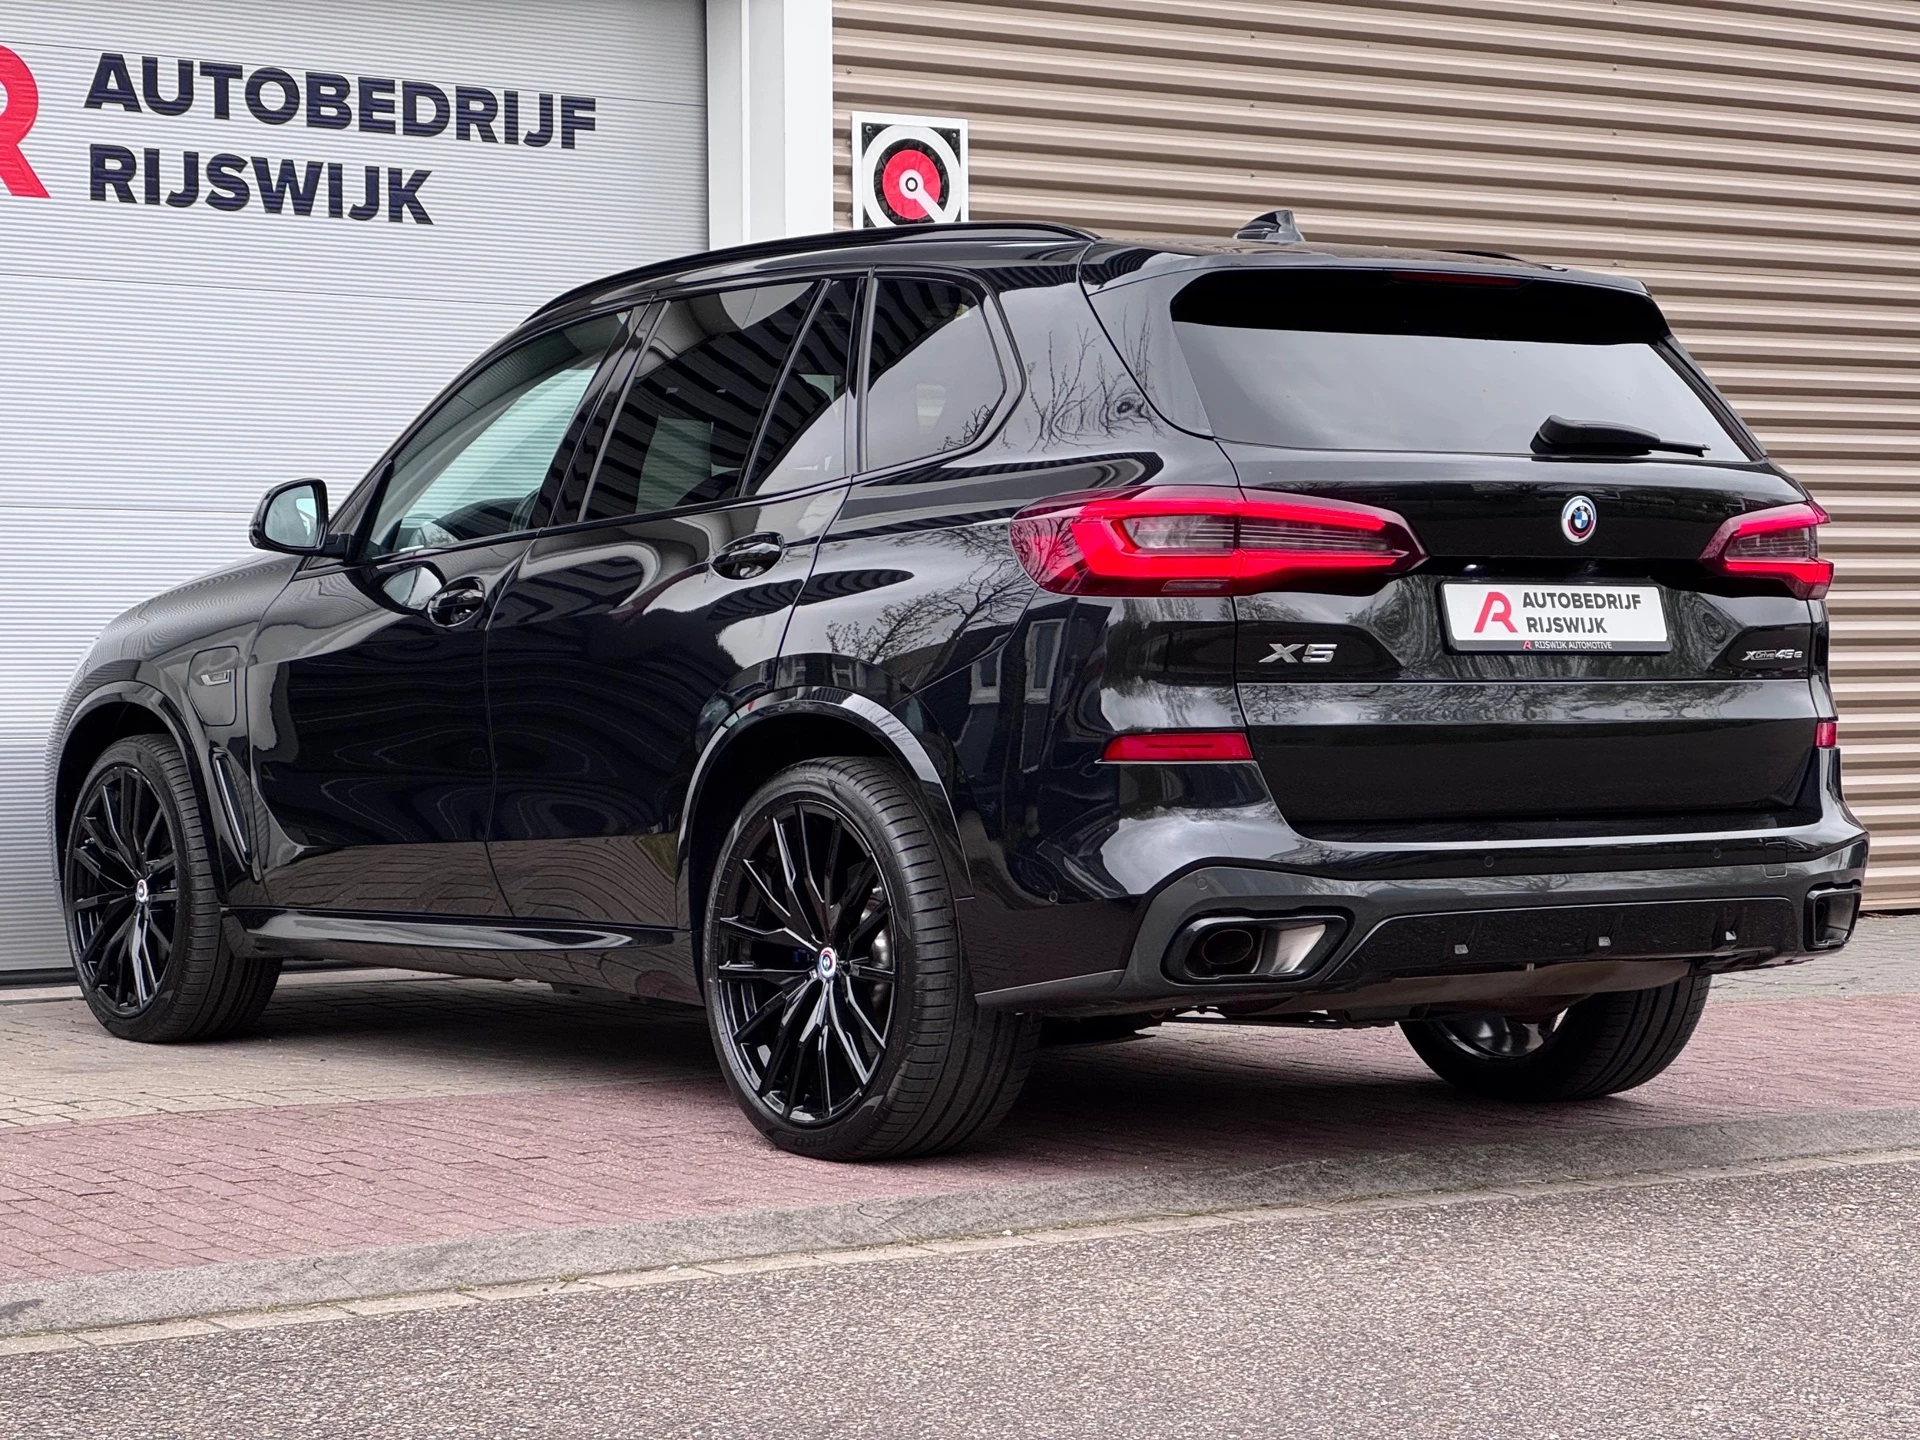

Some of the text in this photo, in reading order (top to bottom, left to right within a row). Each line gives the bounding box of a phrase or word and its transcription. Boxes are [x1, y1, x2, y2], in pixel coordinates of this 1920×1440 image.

[84, 52, 596, 149] AUTOBEDRIJF
[89, 144, 434, 225] RIJSWIJK
[1522, 592, 1642, 609] AUTOBEDRIJF
[1526, 617, 1608, 633] RIJSWIJK
[1258, 643, 1338, 663] X5
[1534, 641, 1567, 649] RIJSWIJK
[1568, 641, 1613, 650] AUTOMOTIVE
